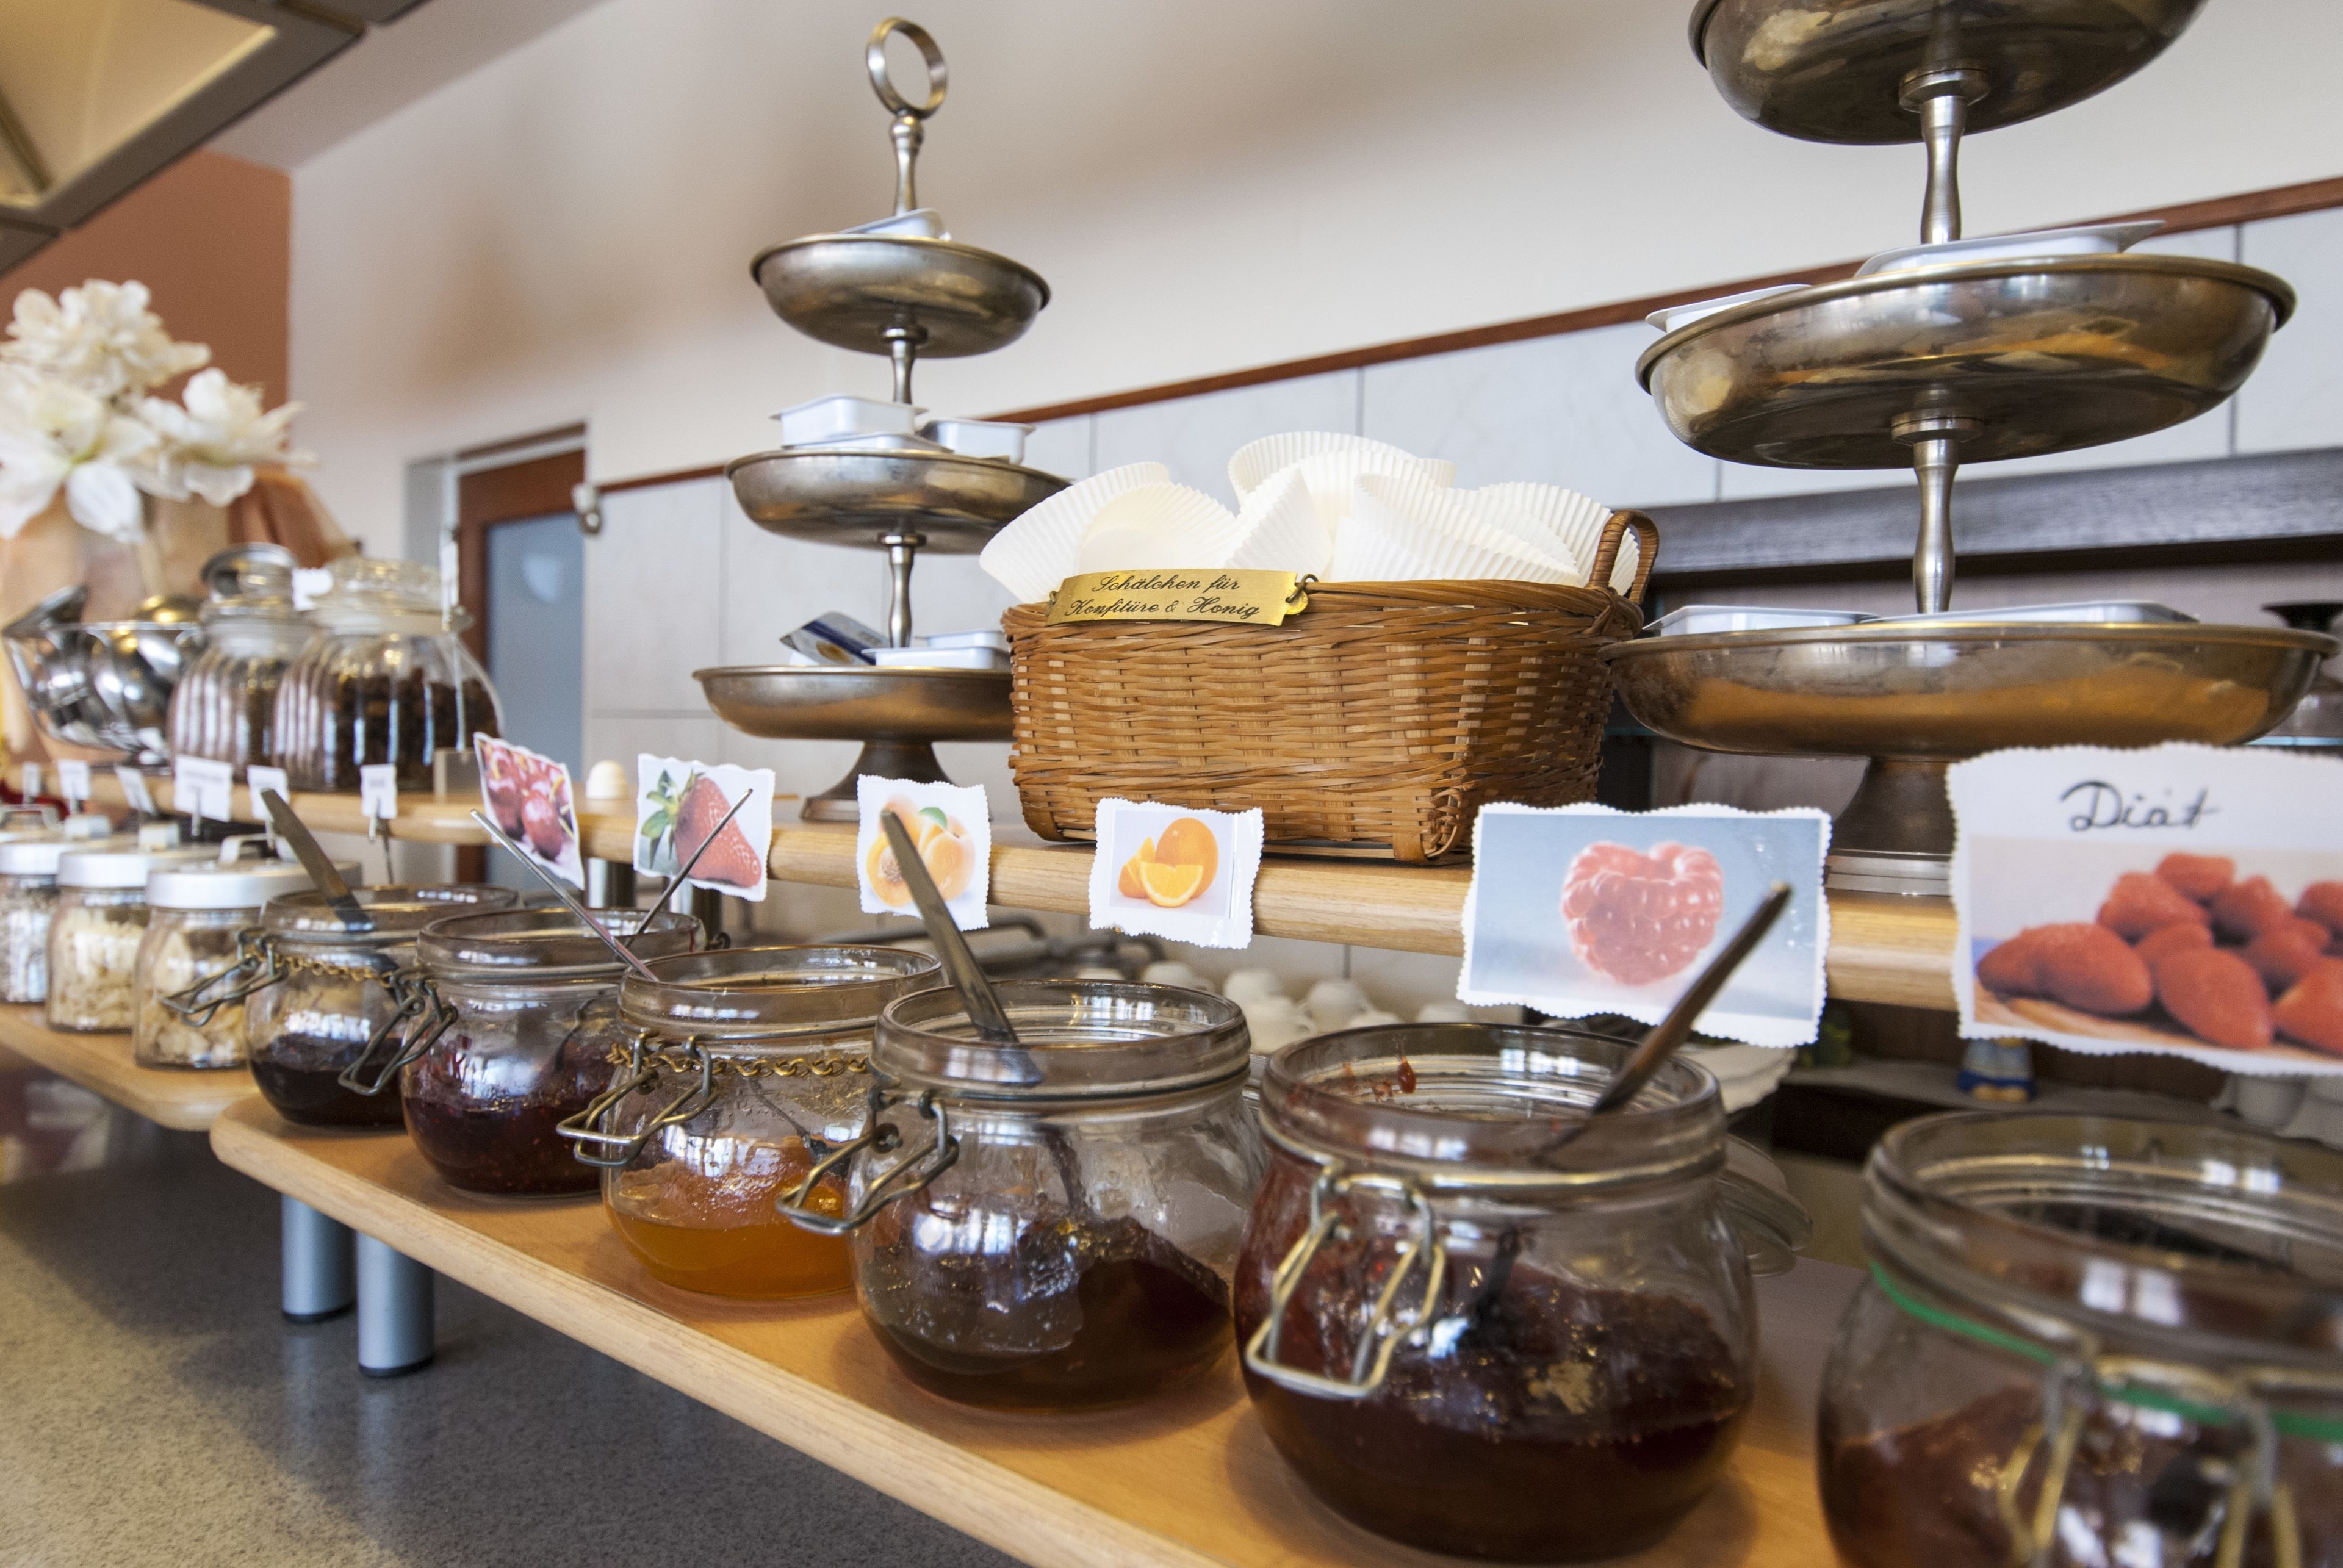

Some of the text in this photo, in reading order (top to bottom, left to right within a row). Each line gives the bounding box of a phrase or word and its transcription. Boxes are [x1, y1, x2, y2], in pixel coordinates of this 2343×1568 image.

[1092, 574, 1240, 594] Schälchen für
[1064, 596, 1260, 620] Konfitüre & Honig
